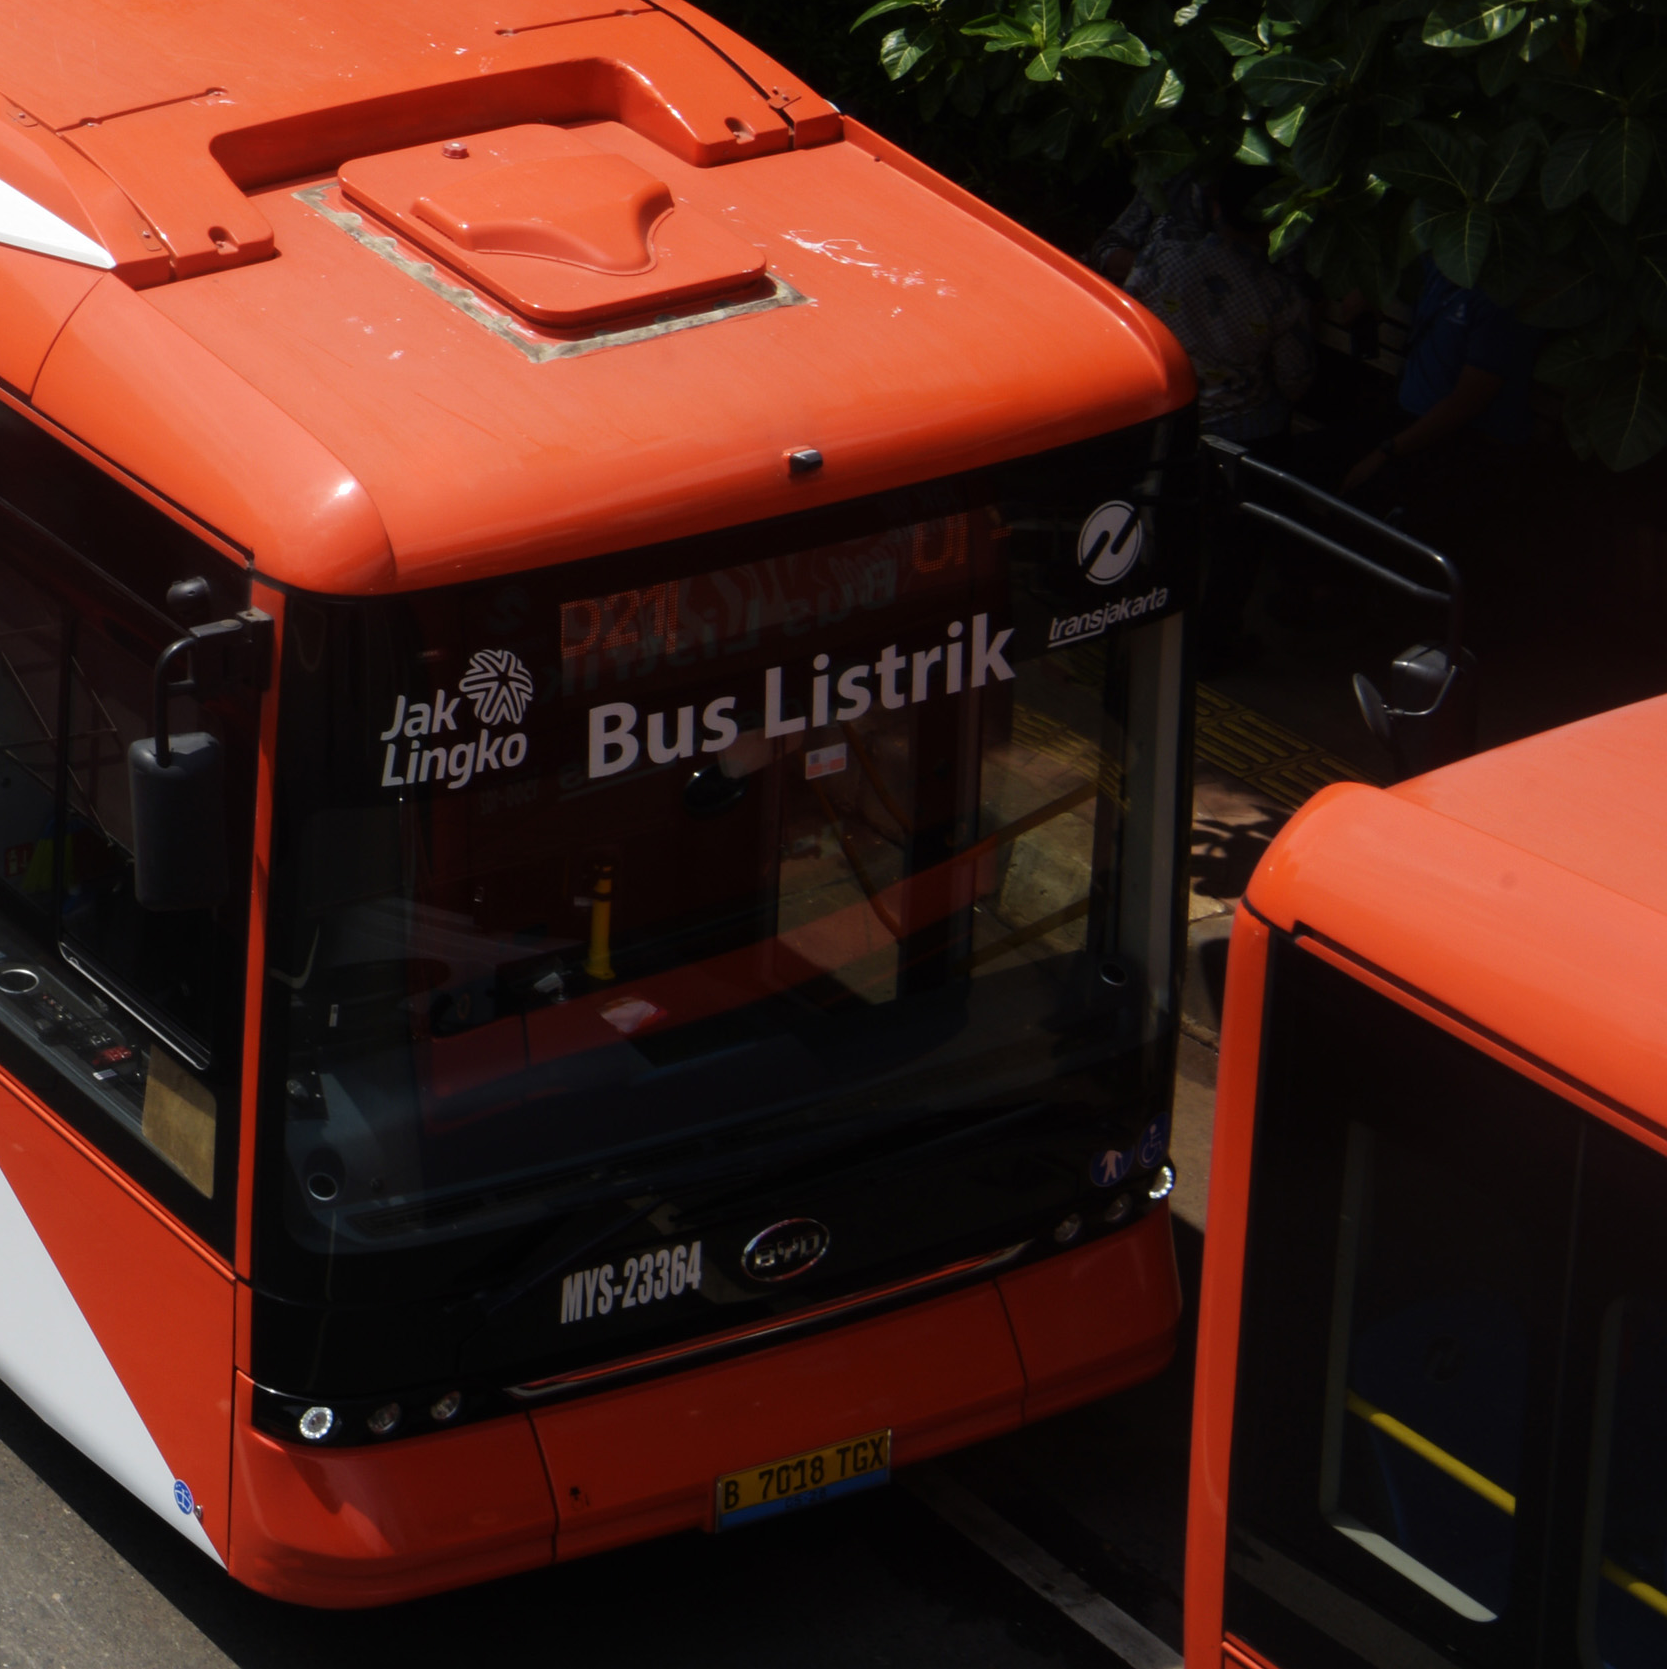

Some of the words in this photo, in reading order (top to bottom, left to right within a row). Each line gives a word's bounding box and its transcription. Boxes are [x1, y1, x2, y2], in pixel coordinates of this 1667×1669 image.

[1047, 586, 1169, 648] transjakarta
[379, 688, 462, 741] Jak
[587, 695, 739, 780] Bus
[764, 611, 1017, 740] Listrik
[380, 728, 528, 790] Lingko
[560, 1239, 703, 1325] MYS-23364
[753, 1234, 820, 1270] BYD
[723, 1479, 740, 1510] B
[758, 1455, 825, 1500] 7018
[836, 1435, 884, 1478] TGX
